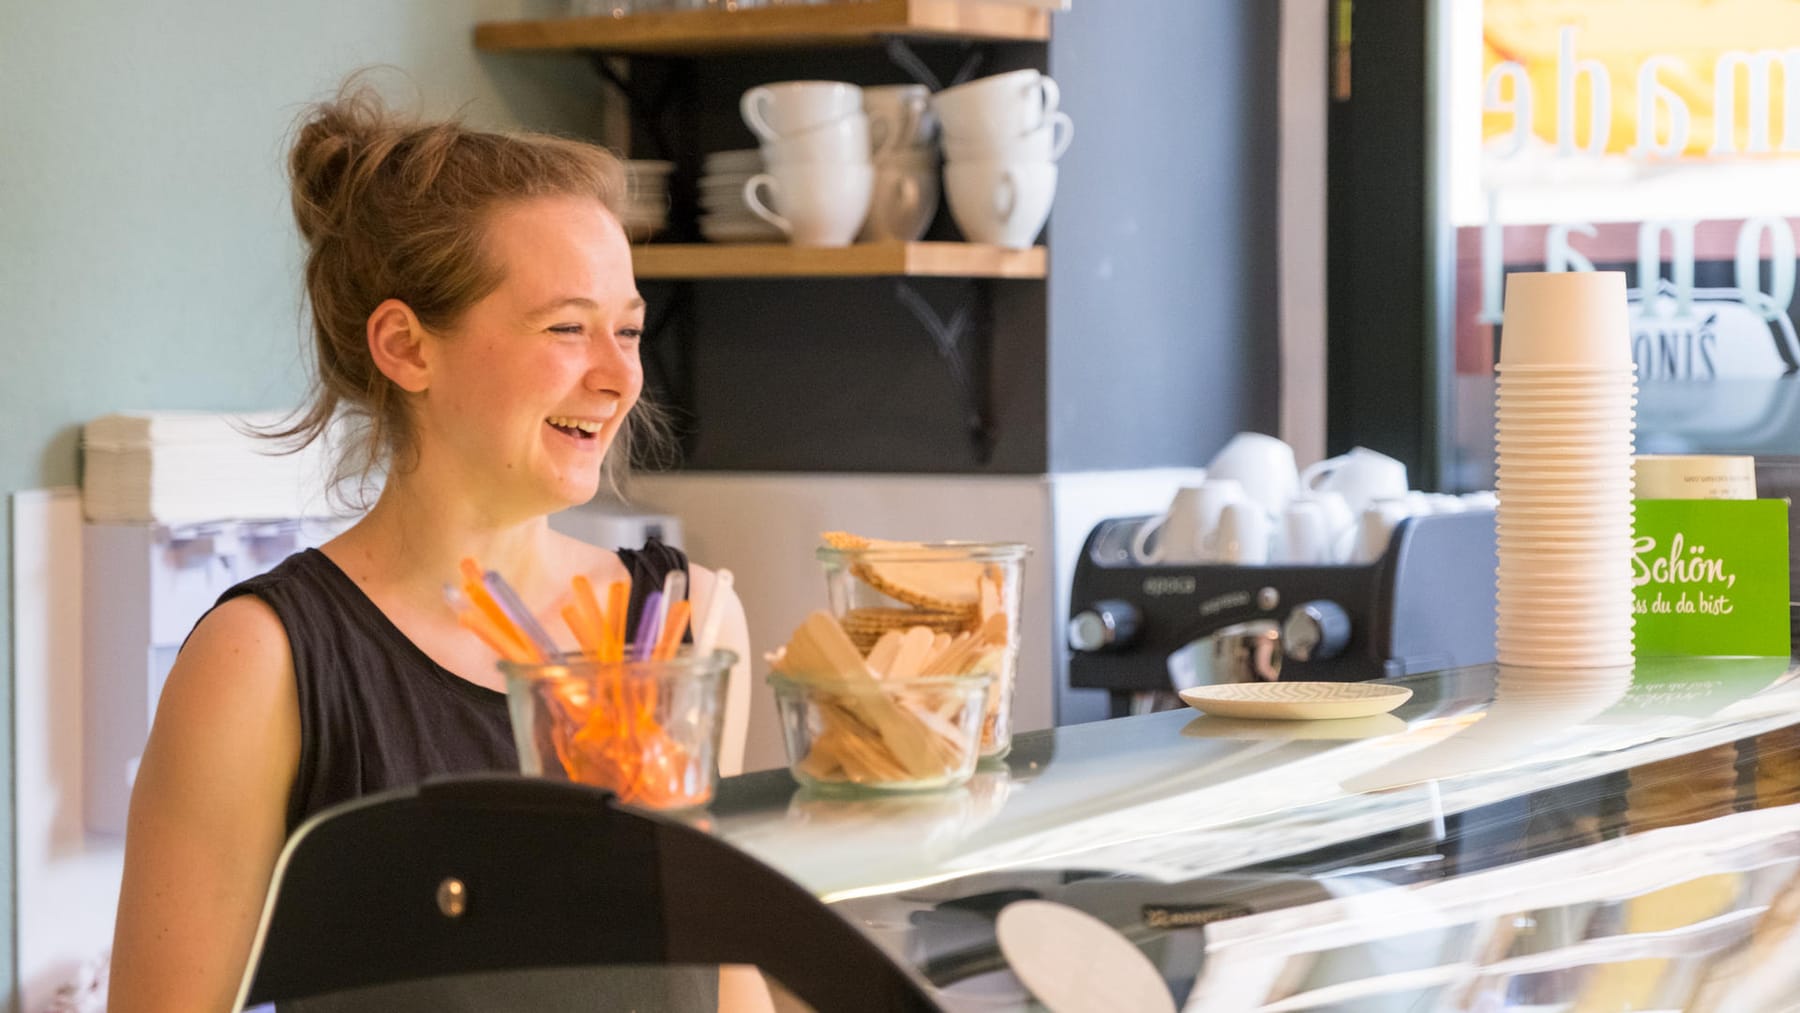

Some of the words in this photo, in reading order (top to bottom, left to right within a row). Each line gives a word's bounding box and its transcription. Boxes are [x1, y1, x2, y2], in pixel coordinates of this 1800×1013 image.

[1631, 532, 1736, 589] Schön,
[1652, 592, 1672, 614] du
[1676, 592, 1696, 614] da
[1699, 591, 1733, 616] bist
